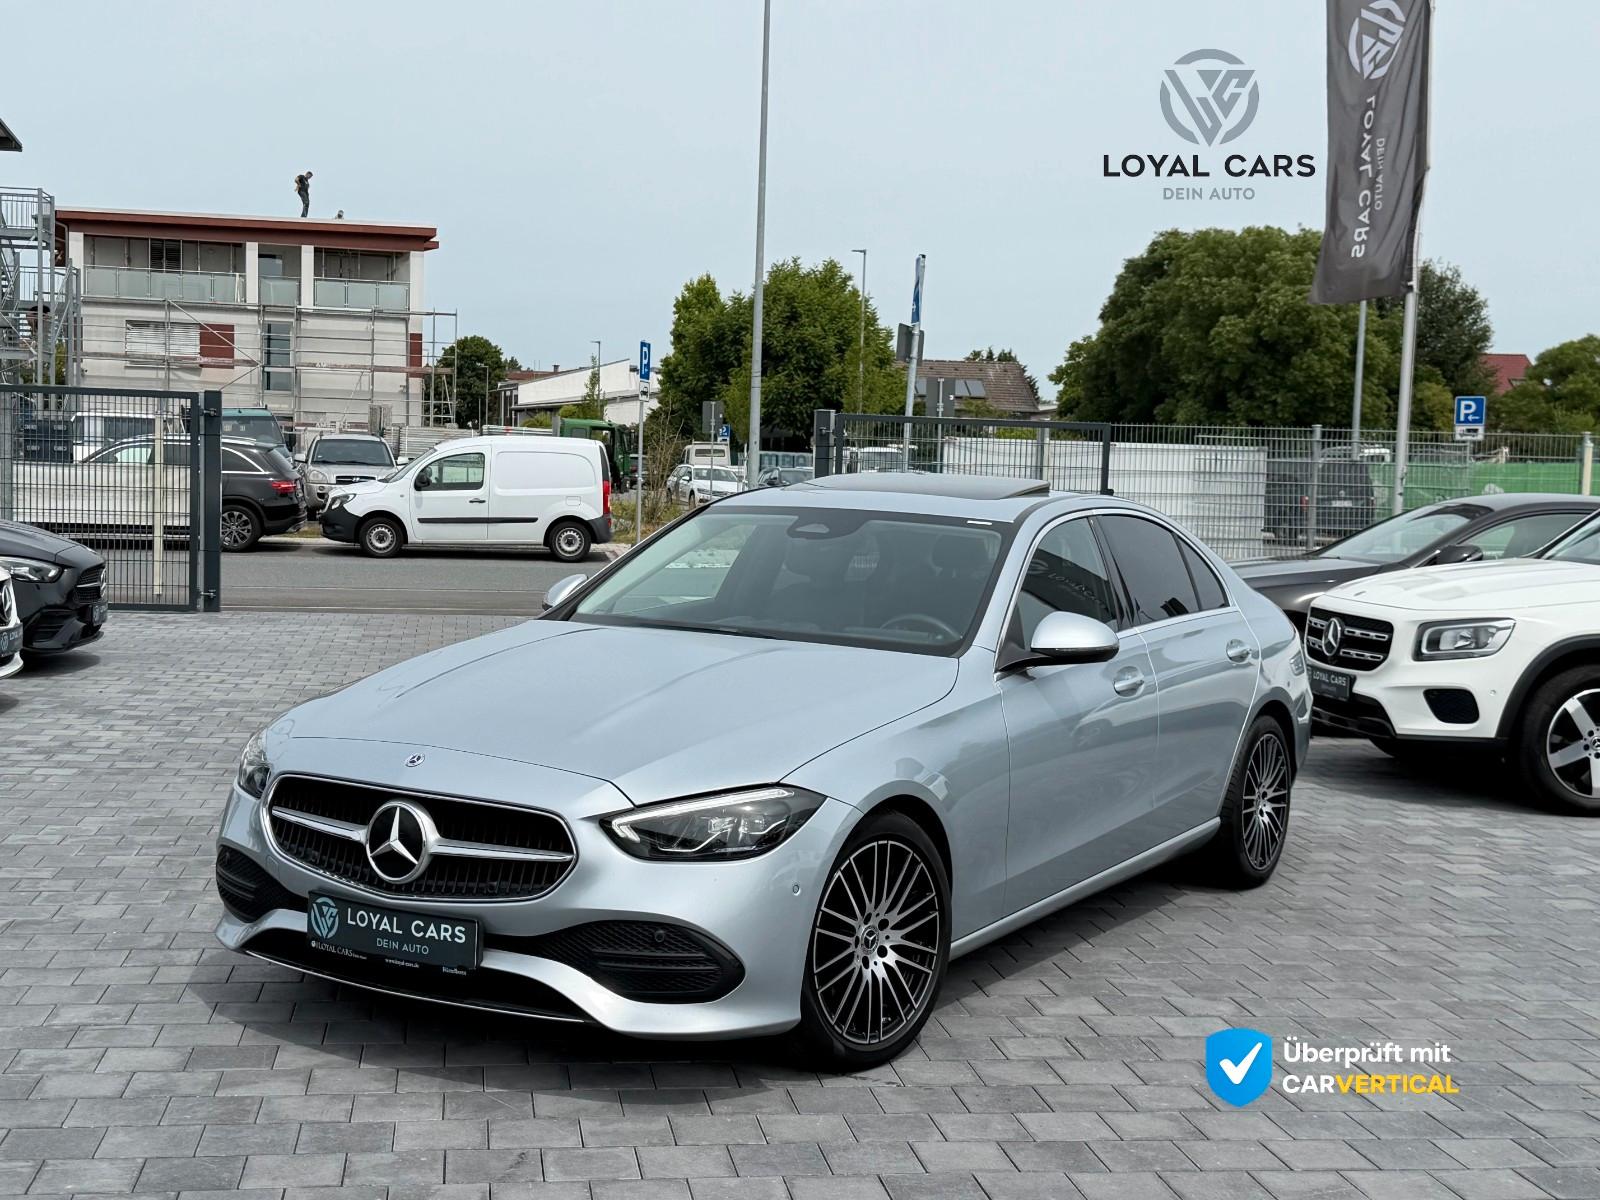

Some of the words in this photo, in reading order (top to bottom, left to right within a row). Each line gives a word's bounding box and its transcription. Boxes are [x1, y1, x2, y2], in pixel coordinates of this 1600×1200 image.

[641, 346, 649, 375] P
[1459, 400, 1476, 422] P
[1330, 674, 1347, 686] CARS
[347, 907, 403, 935] LOYAL
[411, 920, 466, 944] CARS
[376, 937, 399, 951] DEIN
[402, 943, 429, 955] AUTO
